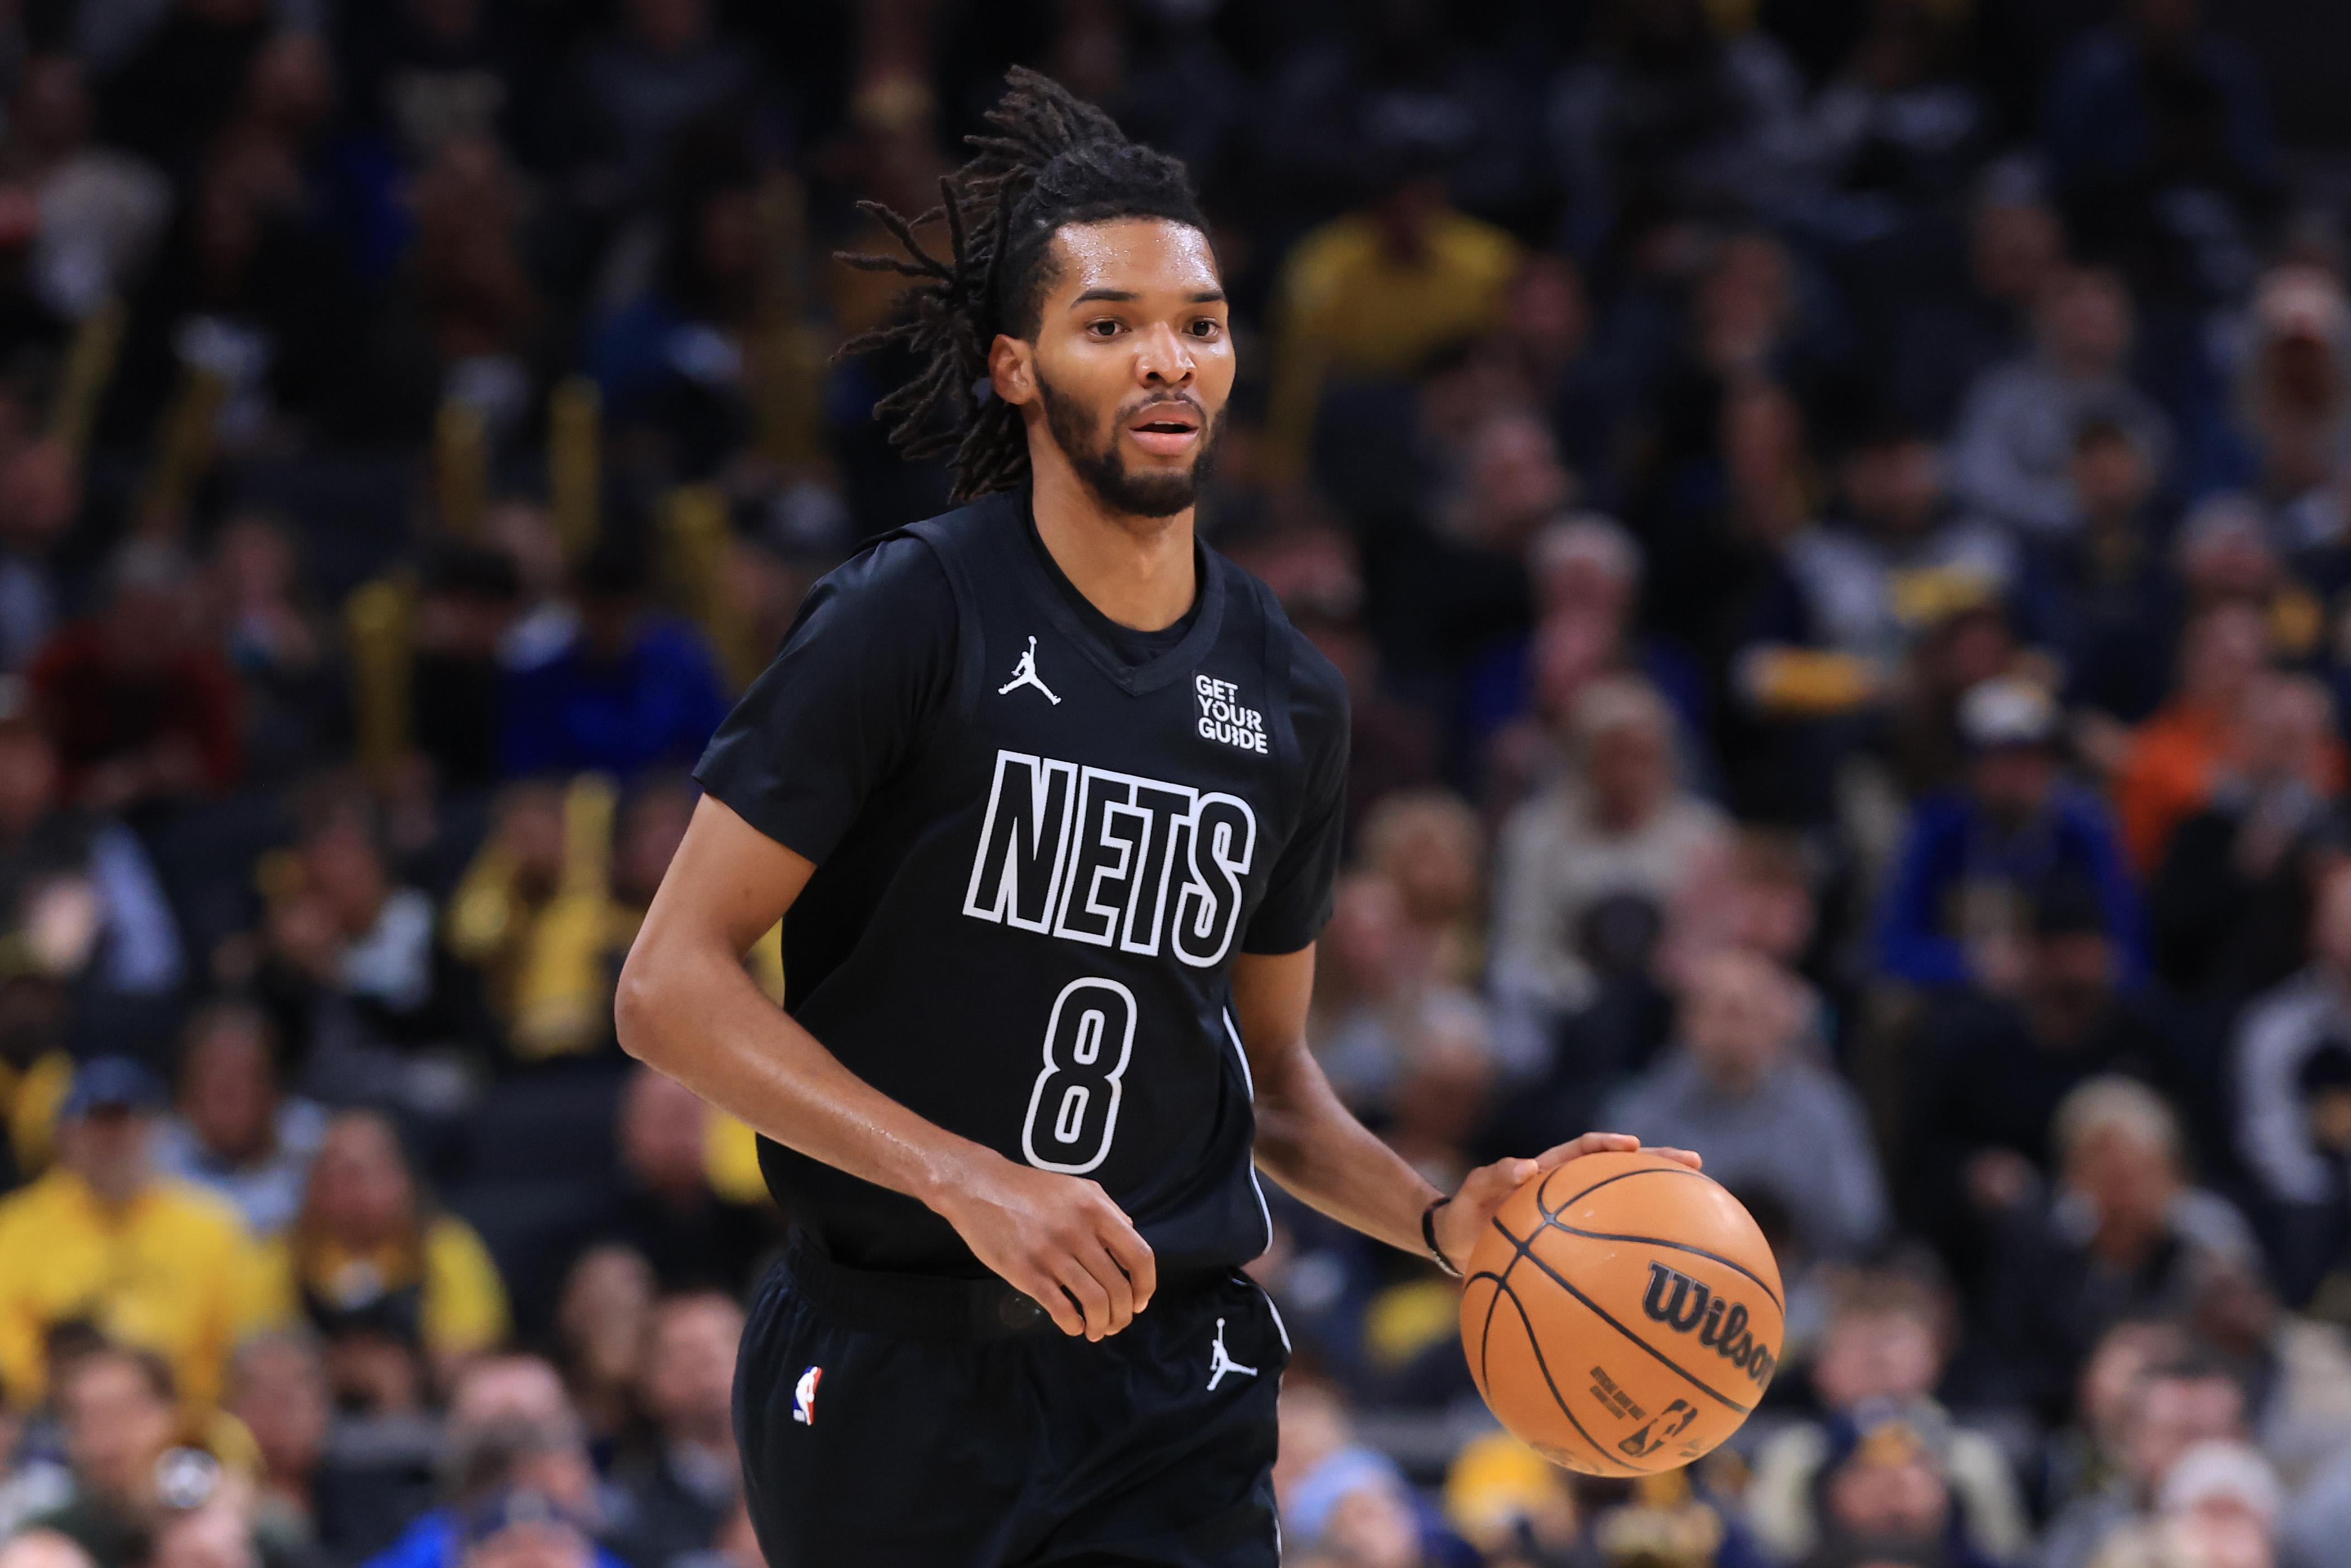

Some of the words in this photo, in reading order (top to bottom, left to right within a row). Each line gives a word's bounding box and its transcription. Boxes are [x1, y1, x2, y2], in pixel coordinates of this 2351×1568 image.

[1196, 674, 1238, 703] GET
[1197, 694, 1263, 732] YOUR
[1198, 717, 1269, 754] GUIDE
[962, 749, 1257, 968] NETS
[1022, 977, 1137, 1175] 8
